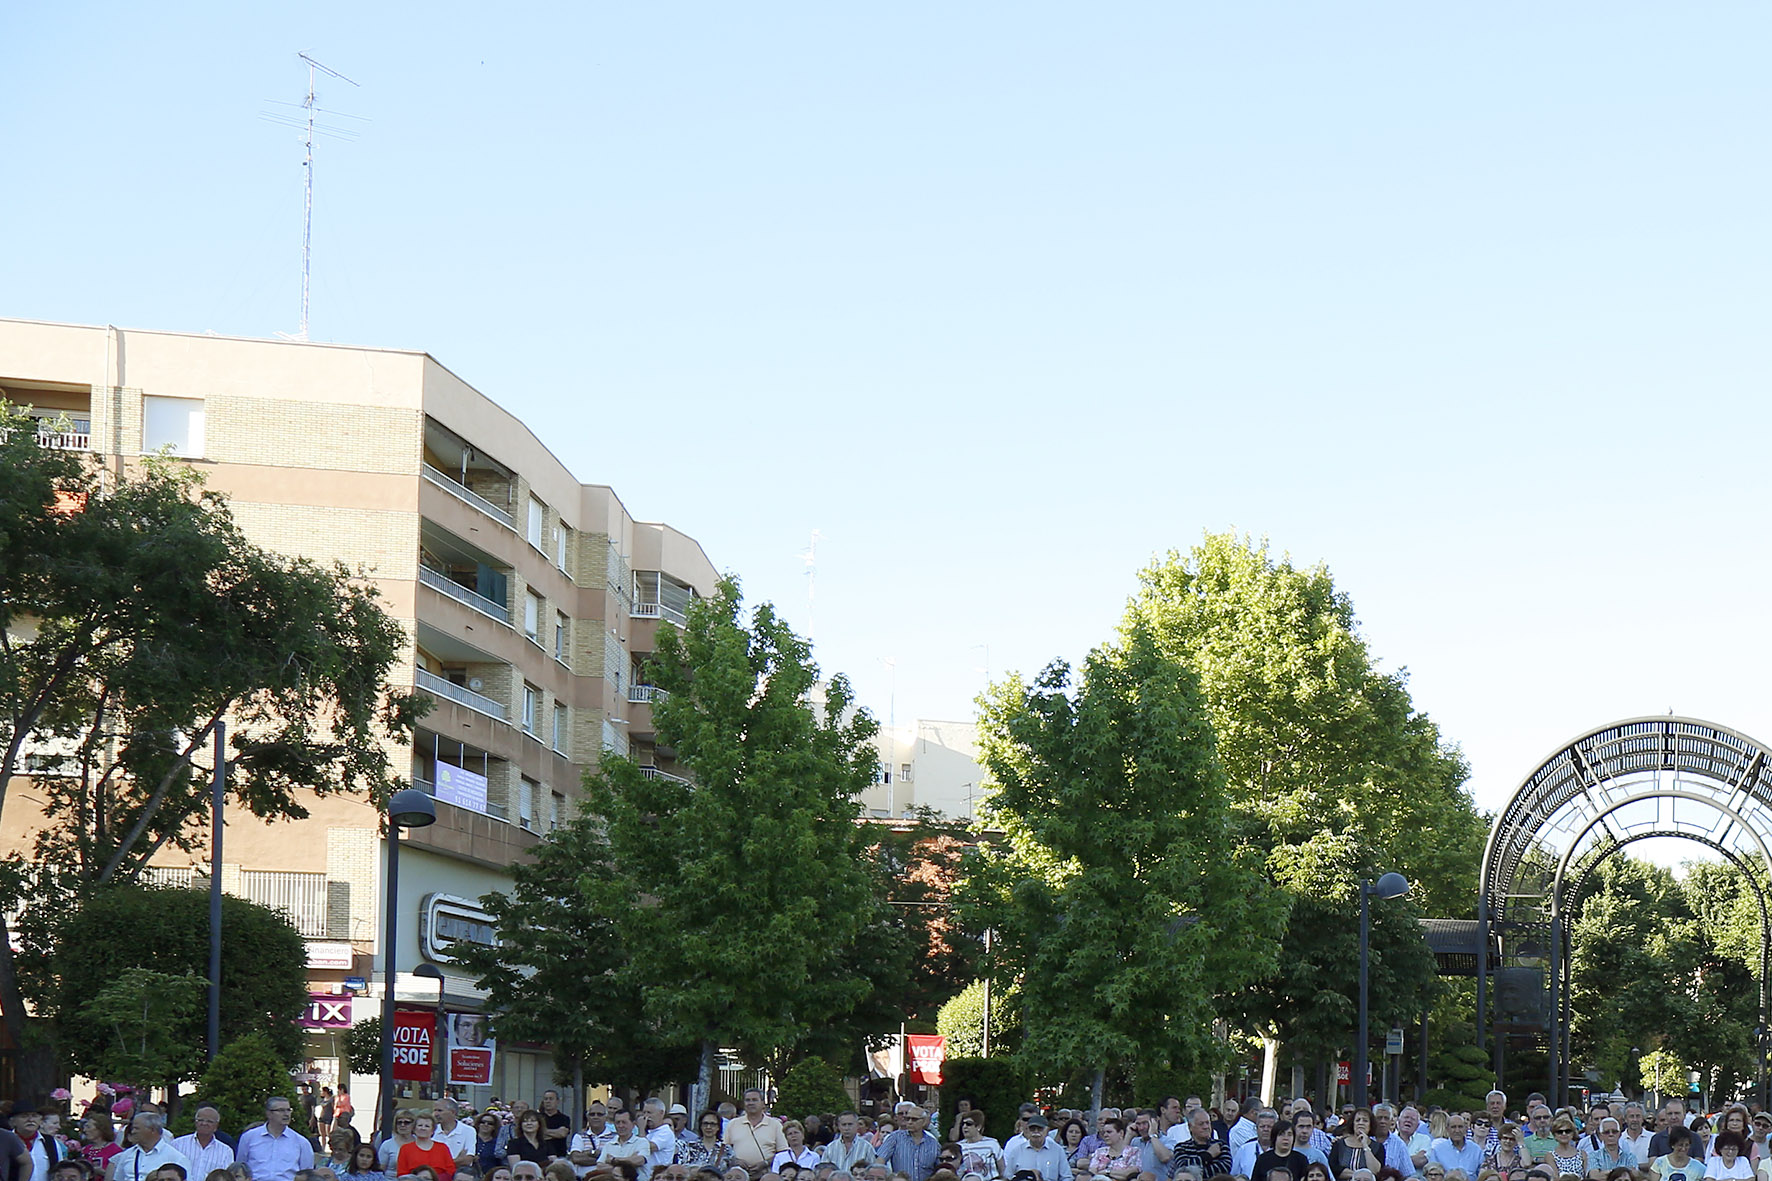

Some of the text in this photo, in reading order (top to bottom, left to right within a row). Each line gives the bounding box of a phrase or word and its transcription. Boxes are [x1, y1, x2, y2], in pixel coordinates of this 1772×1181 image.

[393, 1027, 430, 1044] VOTA
[393, 1047, 429, 1065] PSOE
[911, 1046, 942, 1058] VOTA
